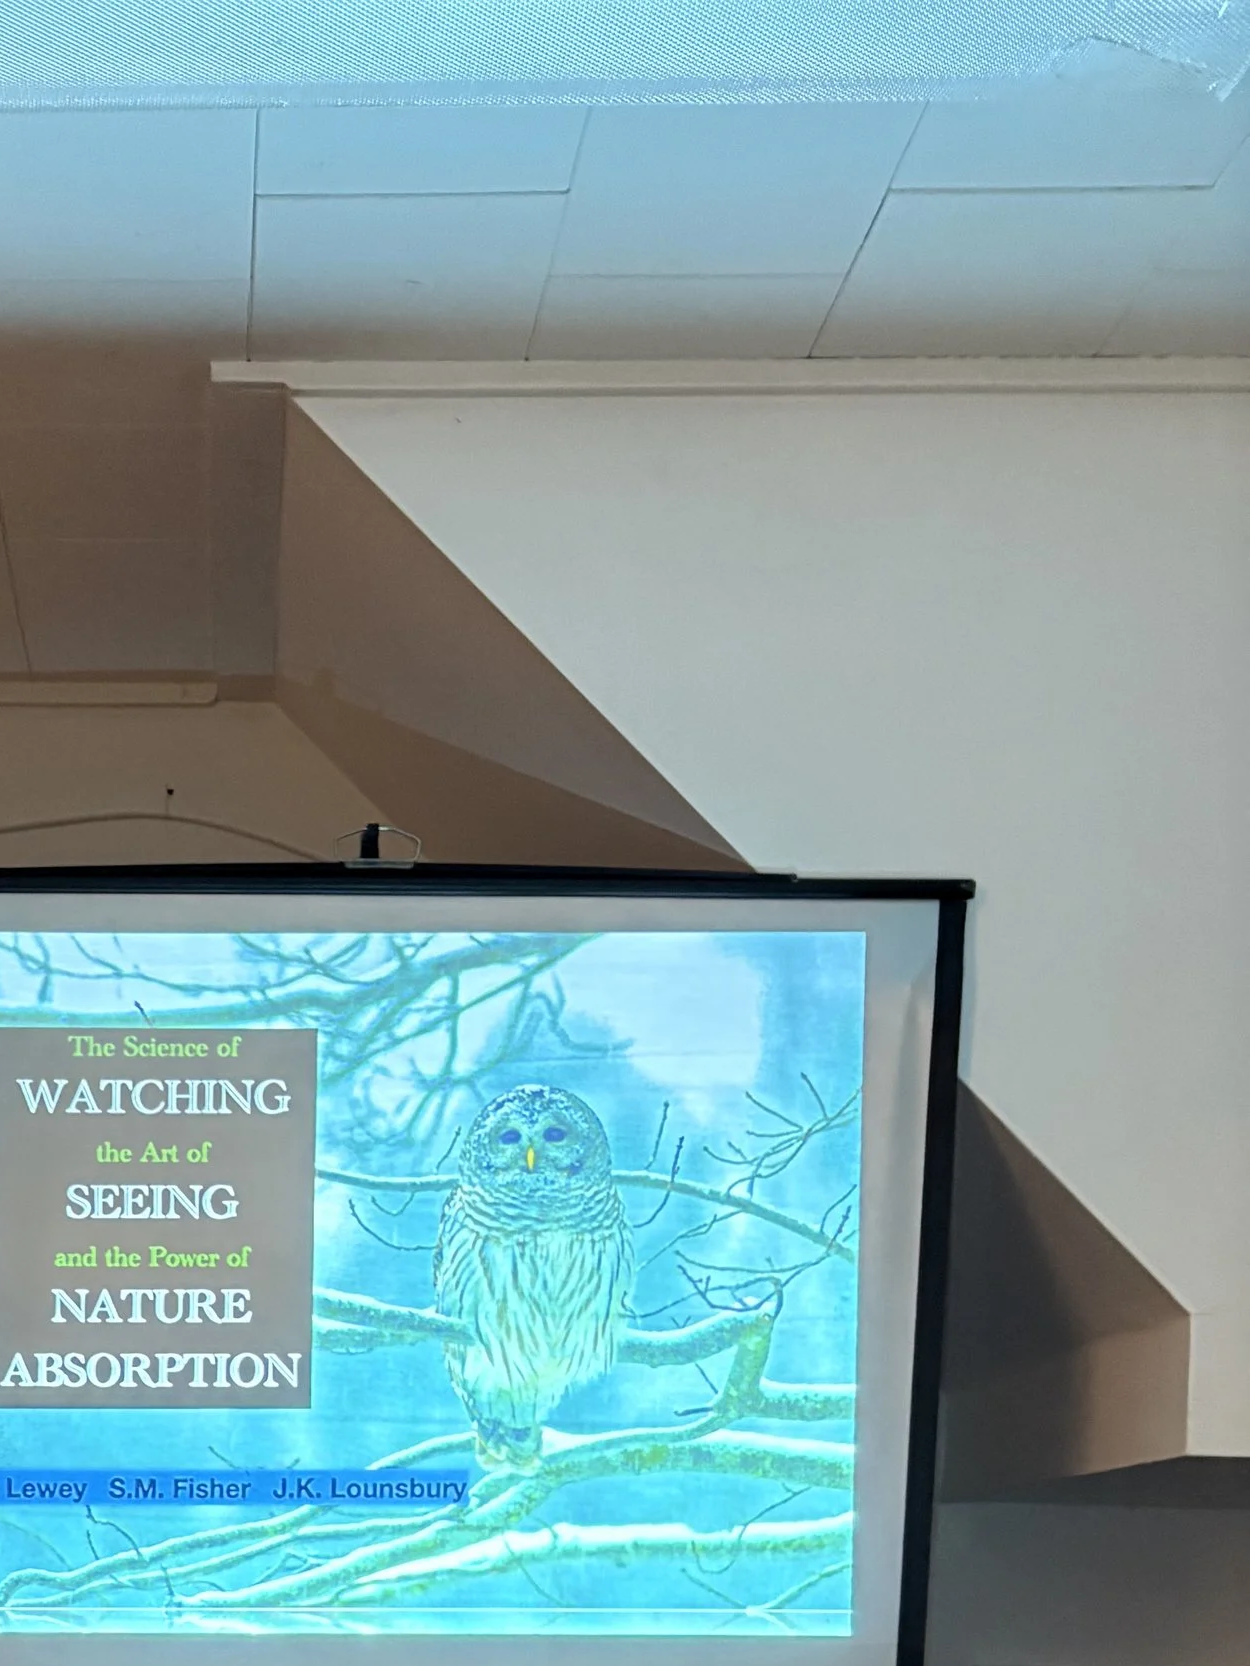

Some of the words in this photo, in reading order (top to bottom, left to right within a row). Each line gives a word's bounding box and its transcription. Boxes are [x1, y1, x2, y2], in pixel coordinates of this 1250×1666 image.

[68, 1035, 116, 1058] The
[122, 1035, 209, 1058] Science
[216, 1036, 242, 1058] of
[15, 1078, 292, 1115] WATCHING
[96, 1142, 133, 1164] the
[139, 1141, 179, 1164] Art
[186, 1141, 213, 1164] of
[65, 1183, 240, 1221] SEEING
[53, 1247, 97, 1268] and
[104, 1246, 141, 1268] the
[148, 1246, 220, 1268] Power
[226, 1246, 252, 1268] of
[50, 1287, 254, 1325] NATURE
[0, 1352, 302, 1389] ABSORPTION
[6, 1477, 87, 1503] Lewey
[109, 1477, 164, 1499] S.M.
[173, 1477, 251, 1499] Fisher
[273, 1477, 322, 1499] J.K.
[330, 1477, 467, 1503] Lounsbury
